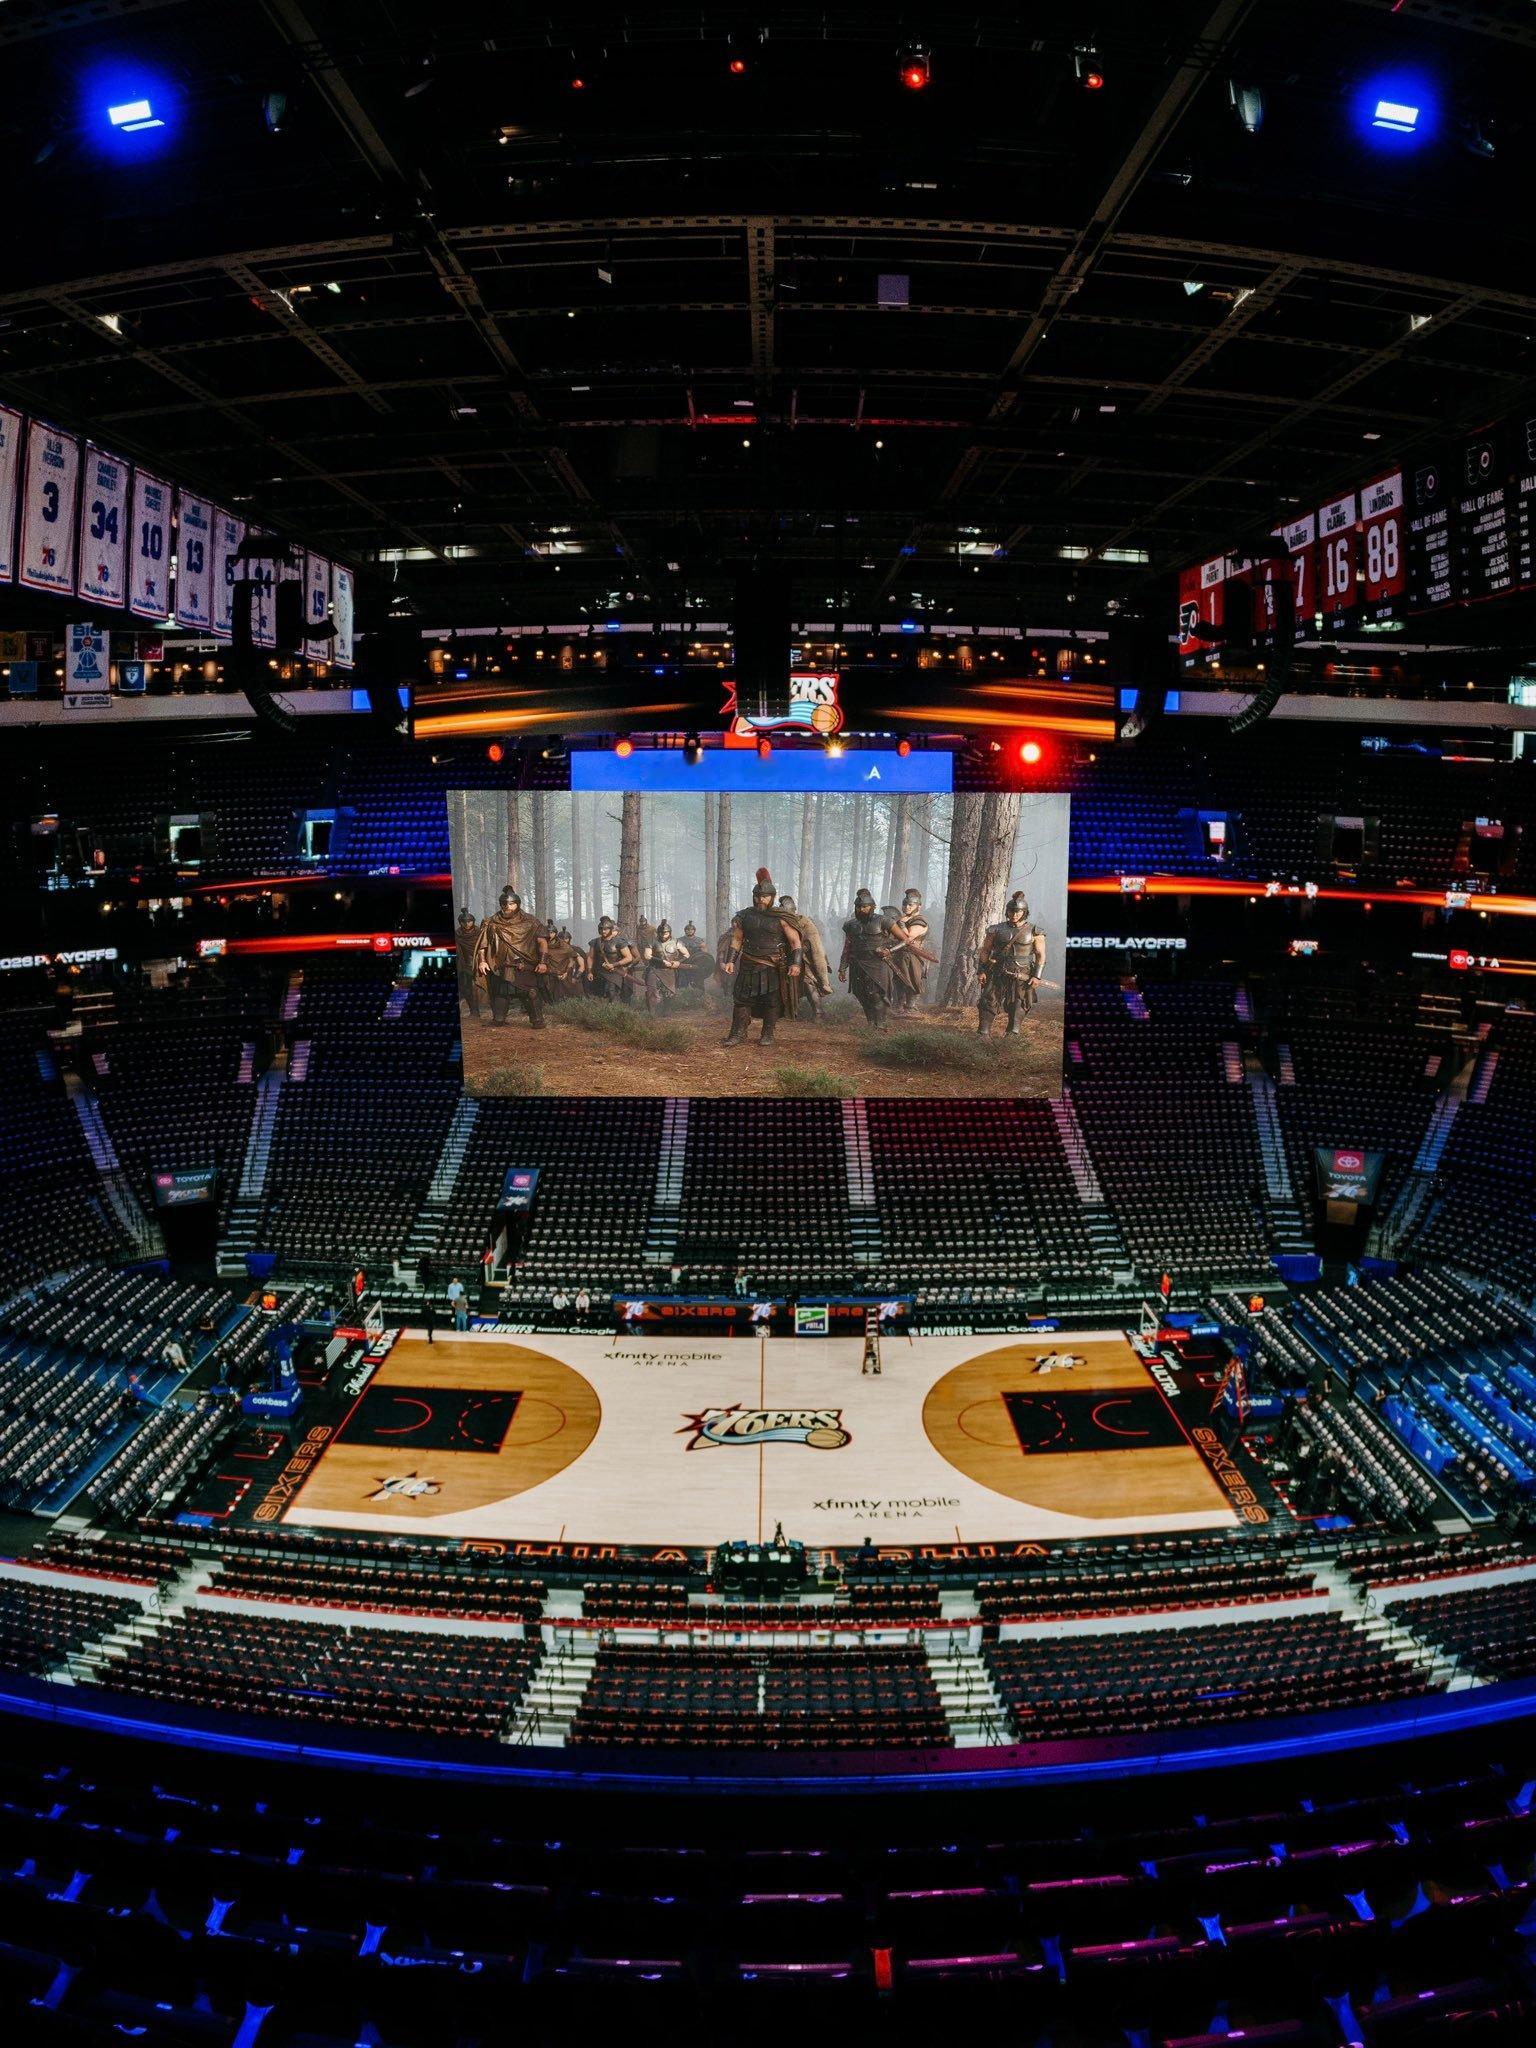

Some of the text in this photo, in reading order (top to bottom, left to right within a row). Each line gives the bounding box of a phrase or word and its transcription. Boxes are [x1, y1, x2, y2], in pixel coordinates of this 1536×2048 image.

[42, 481, 59, 523] 3
[1369, 490, 1394, 514] LINDROS
[1460, 499, 1476, 514] HALL
[1477, 495, 1486, 509] OF
[1486, 488, 1504, 507] FAME
[91, 500, 118, 544] 34
[141, 521, 162, 560] 10
[1367, 518, 1399, 583] 88
[42, 546, 55, 567] 76
[186, 538, 204, 574] 13
[1327, 537, 1349, 596] 16
[1293, 555, 1305, 607] 7
[869, 766, 881, 779] A
[392, 936, 432, 947] TOYOTA
[1066, 937, 1187, 949] 2026 PLAYOFFS
[0, 948, 118, 970] 026 PAYOFFS
[175, 1174, 212, 1183] TOYOTA
[1328, 1172, 1367, 1182] TOYOTA
[660, 1306, 737, 1316] SIXERS
[788, 1306, 864, 1317] SERS
[480, 1323, 535, 1334] PLAYOFFS
[568, 1326, 617, 1335] Google
[919, 1326, 973, 1336] PLAYOFFS
[1007, 1325, 1055, 1333] Google
[603, 1351, 722, 1360] xfinity mobile
[1150, 1364, 1181, 1397] ULTRA
[252, 1397, 288, 1407] coinbase
[1236, 1398, 1272, 1407] conbase
[693, 1407, 841, 1449] 76ERS
[252, 1425, 333, 1522] SIXERS
[1192, 1427, 1270, 1524] SIXERS
[813, 1496, 961, 1511] xfinity mobile
[854, 1511, 923, 1519] ARENA
